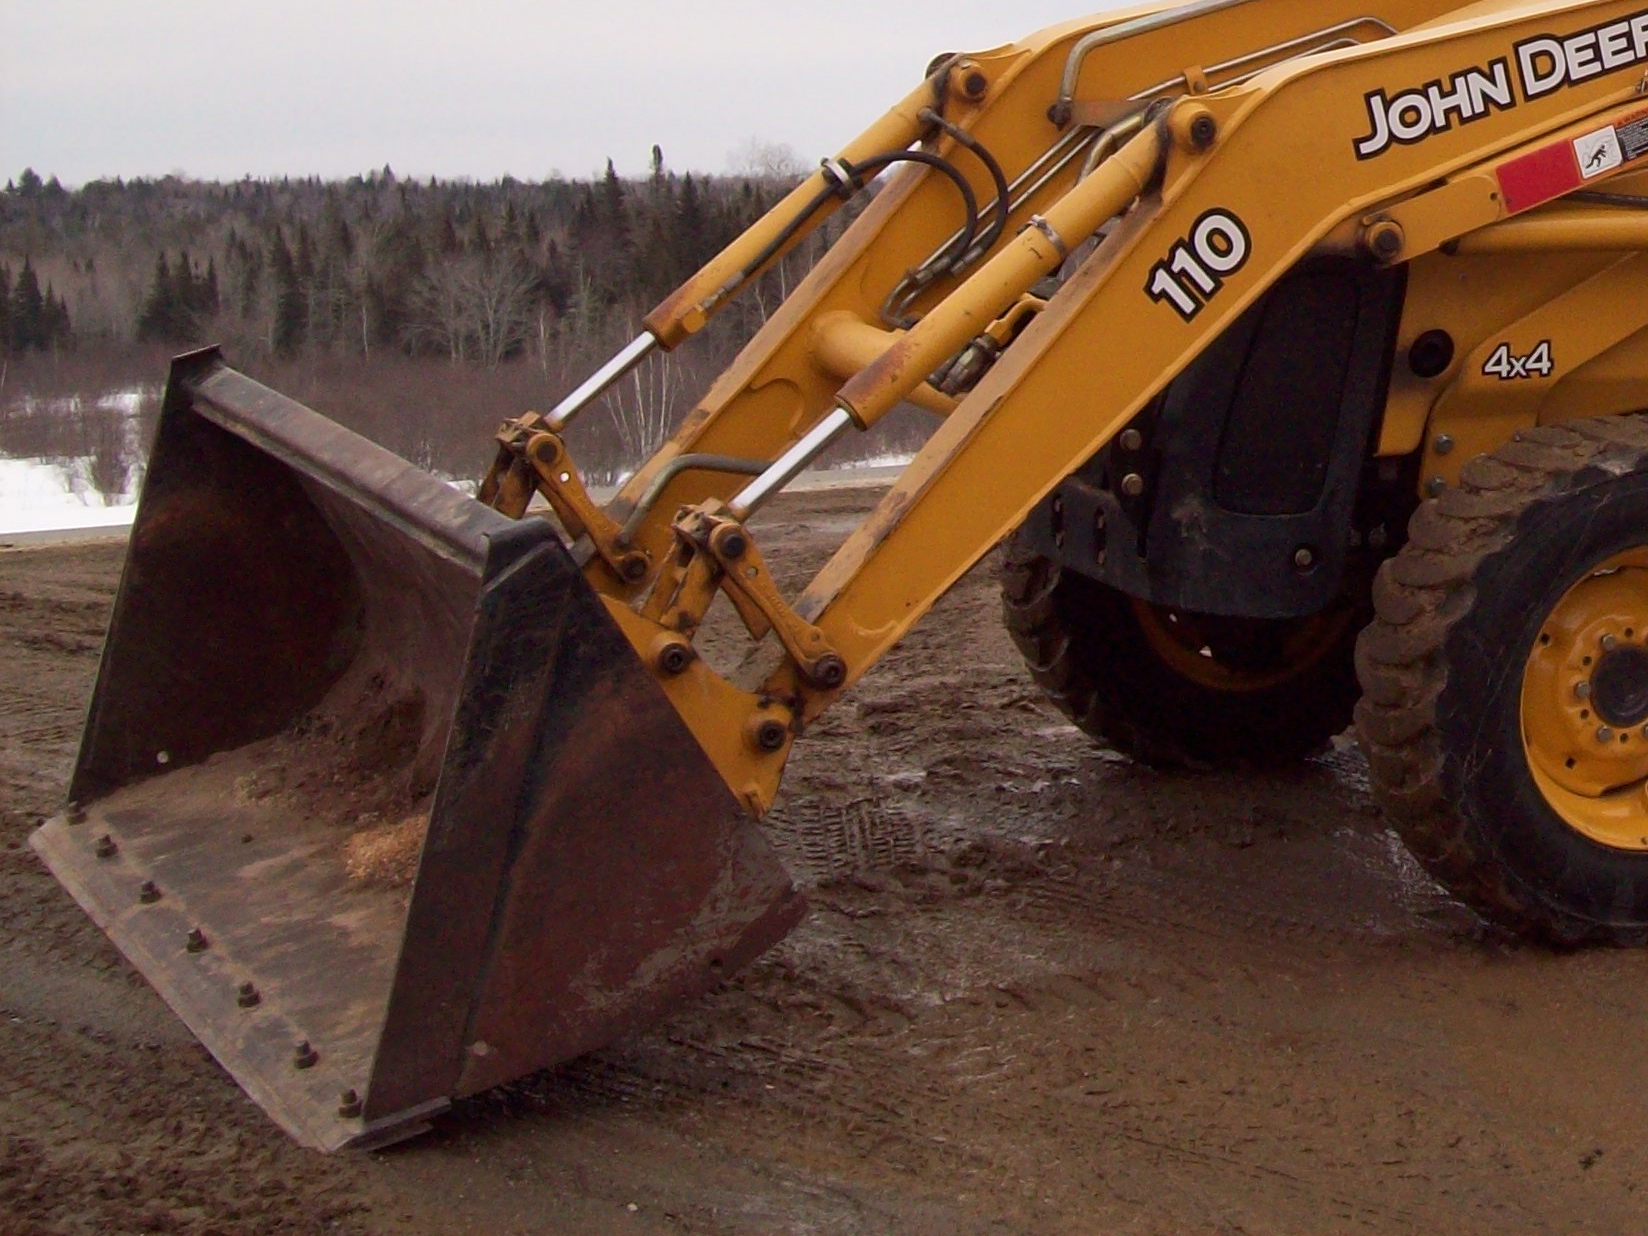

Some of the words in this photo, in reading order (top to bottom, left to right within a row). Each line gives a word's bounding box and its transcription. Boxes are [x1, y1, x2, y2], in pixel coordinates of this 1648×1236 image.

[1358, 61, 1512, 155] JOHN
[1150, 213, 1247, 315] 110
[1483, 342, 1552, 378] 4x4
